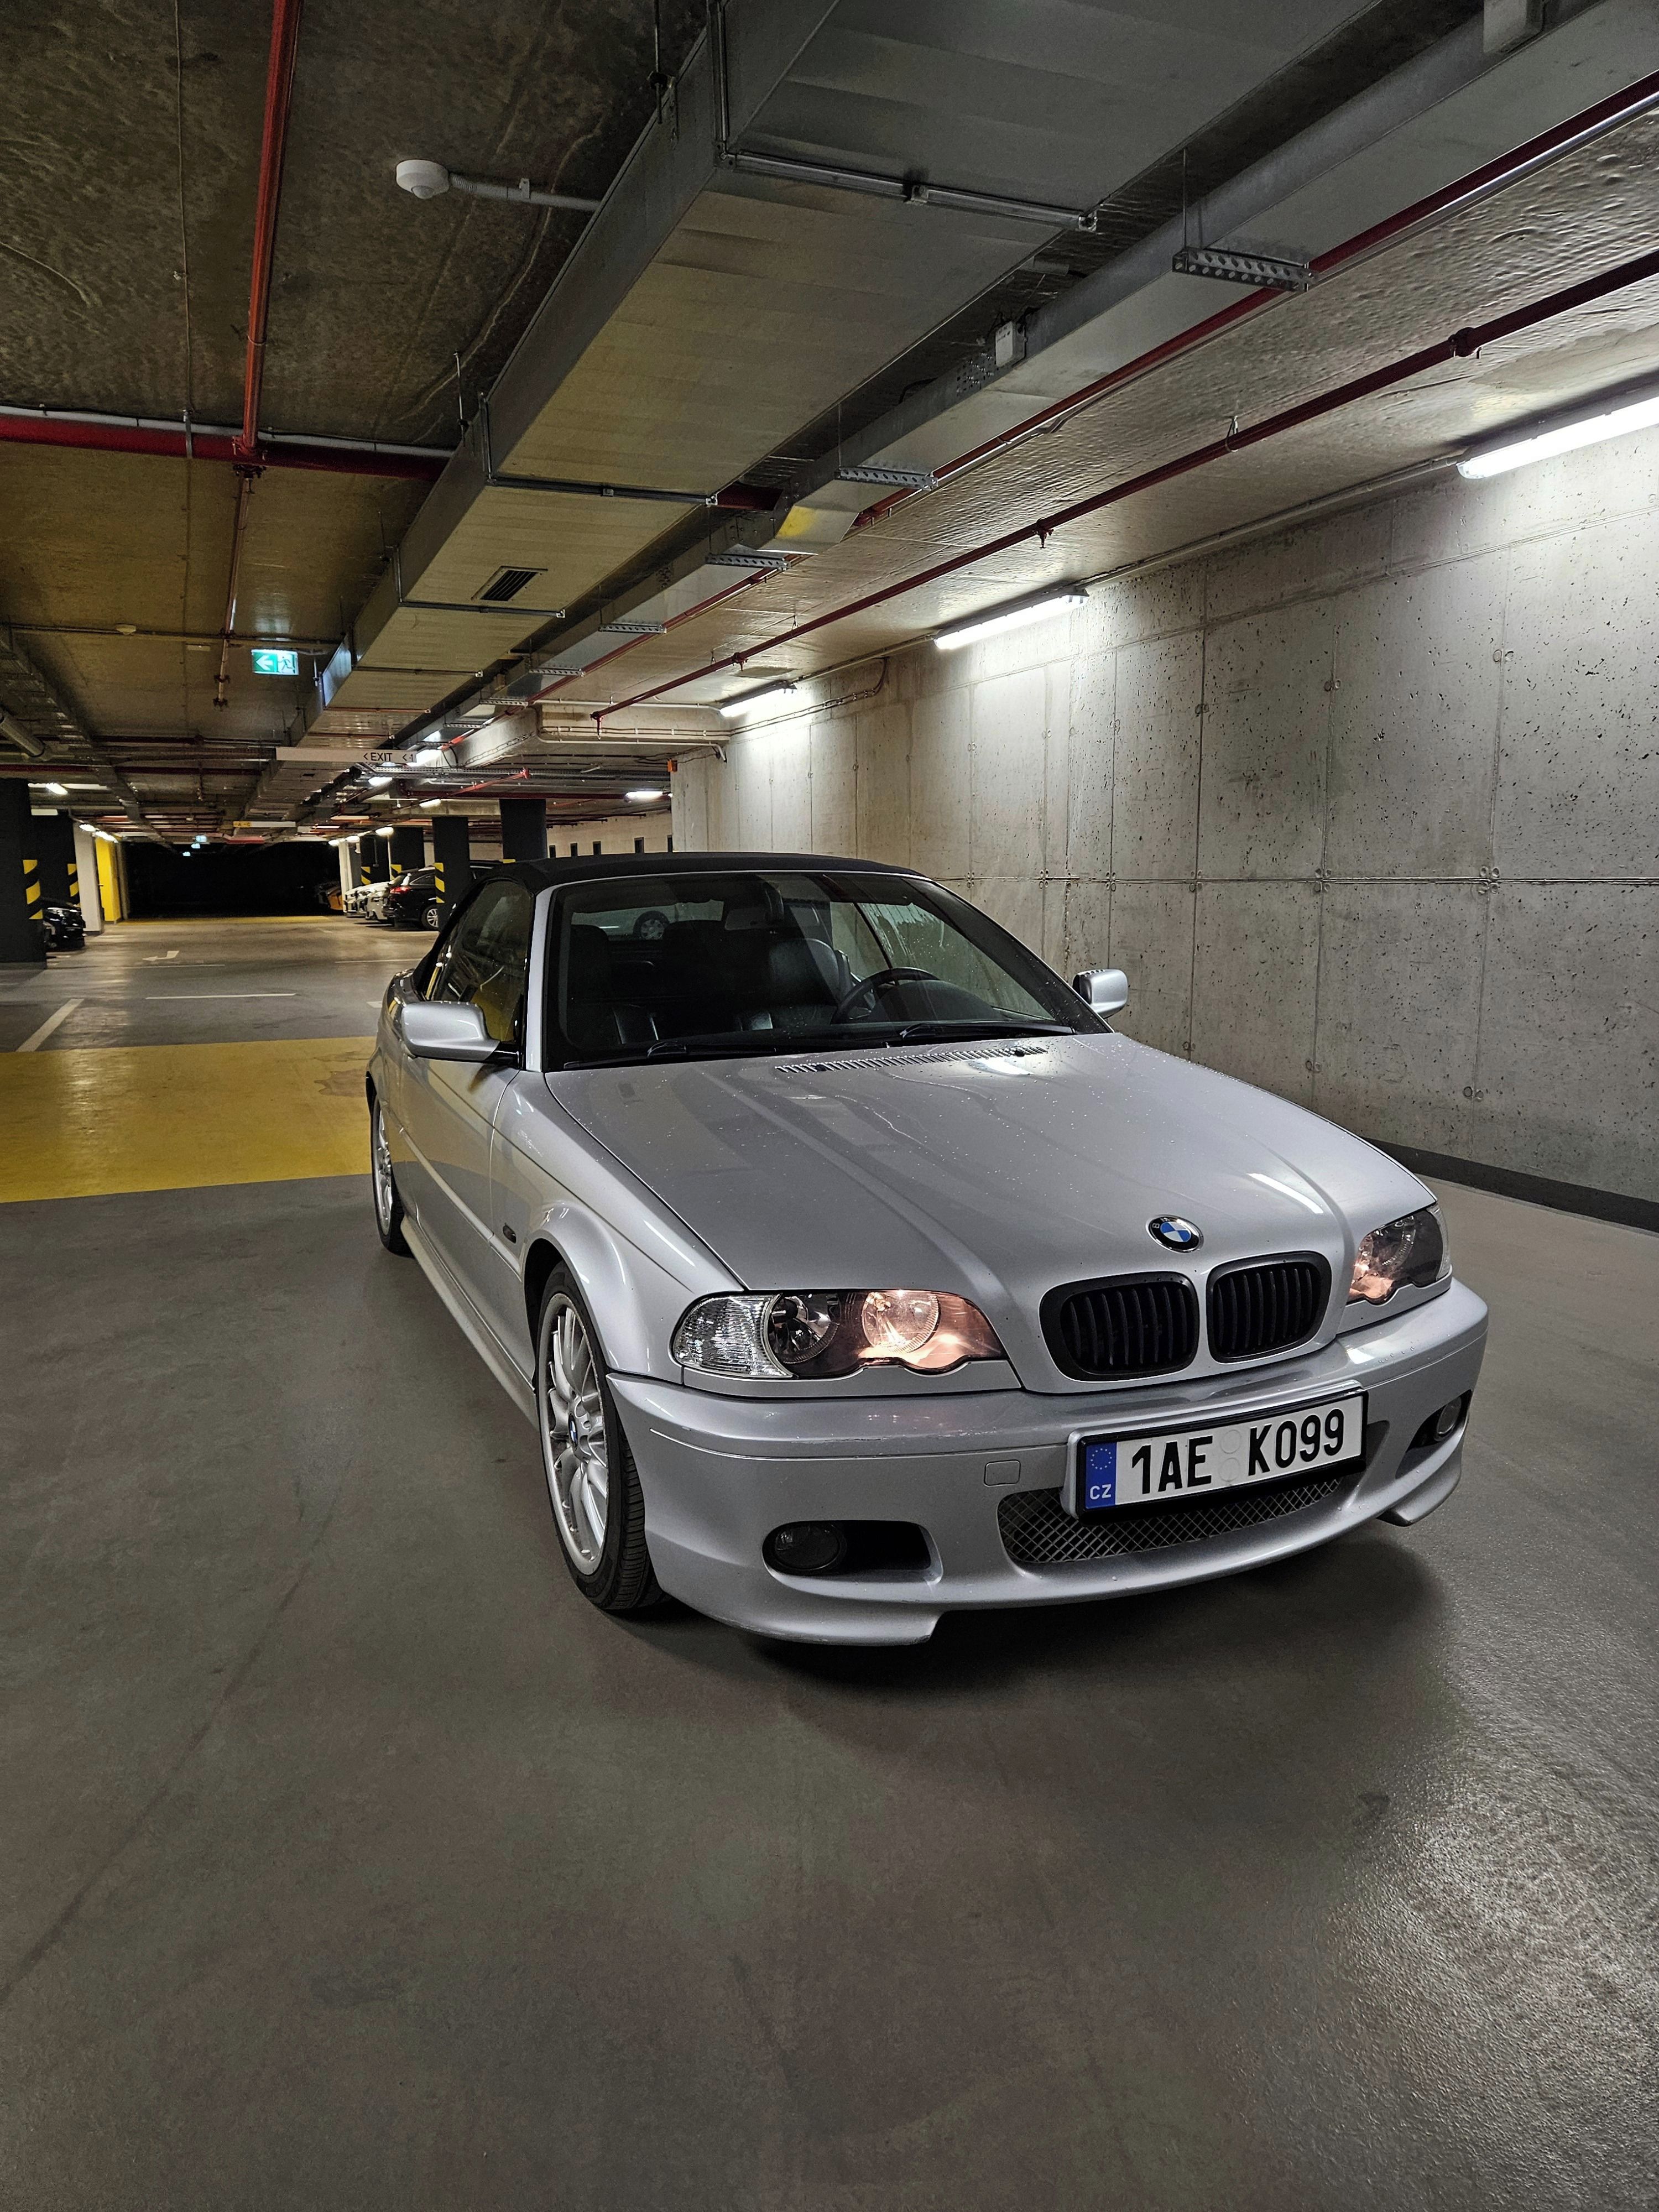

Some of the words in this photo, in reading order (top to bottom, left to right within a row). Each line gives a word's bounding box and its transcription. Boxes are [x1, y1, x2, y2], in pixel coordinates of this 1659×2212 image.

[371, 752, 393, 761] EXIT
[1131, 1435, 1213, 1494] 1AE
[1248, 1408, 1345, 1476] K099
[1090, 1484, 1112, 1500] CZ
